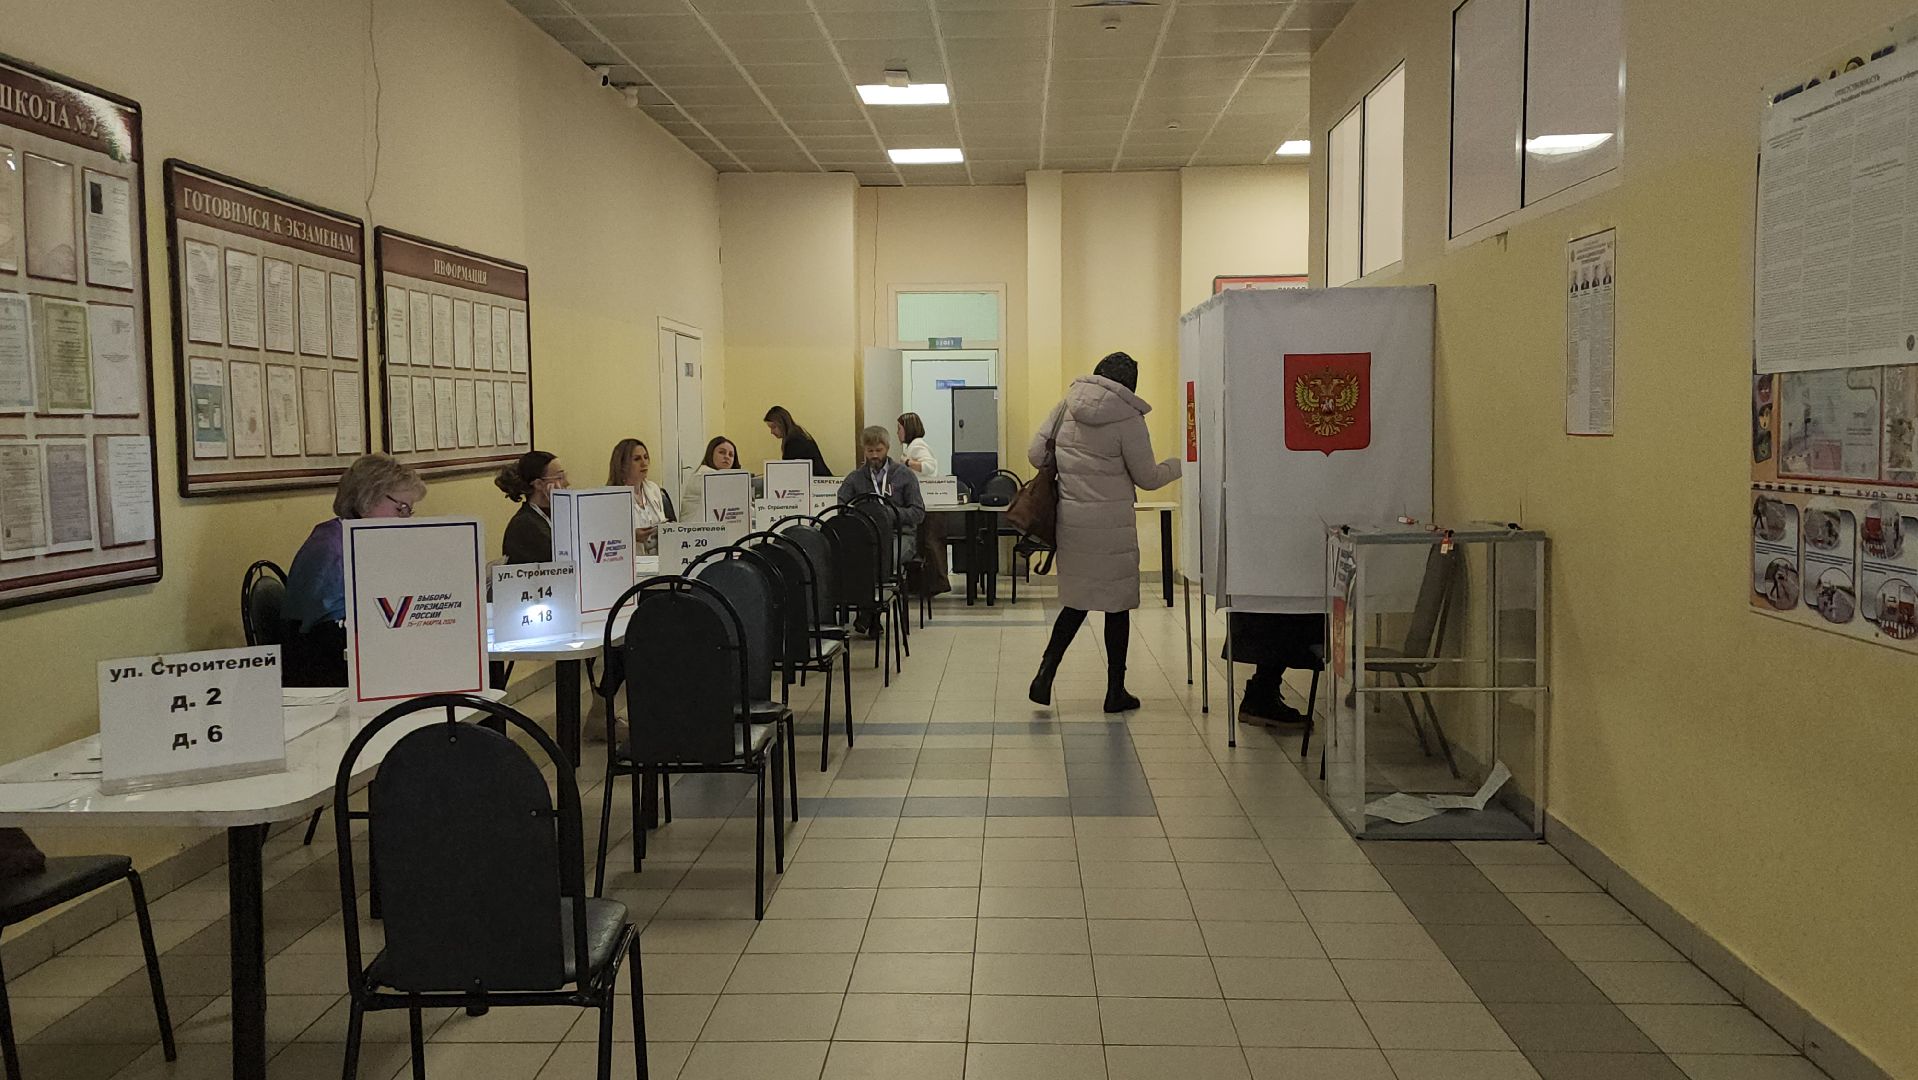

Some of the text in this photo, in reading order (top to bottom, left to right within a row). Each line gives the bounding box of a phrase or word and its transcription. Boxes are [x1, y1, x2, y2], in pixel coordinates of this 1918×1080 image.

[184, 187, 355, 253] ГОТОВИМСЯ К ЭКЗАМЕНАМ
[434, 259, 487, 285] ИНФОРМАЦИЯ
[678, 525, 726, 534] Строителей
[681, 539, 708, 549] д. 20
[498, 565, 574, 582] ул. Строителей
[417, 593, 453, 602] ВЫБОРЫ
[521, 586, 553, 602] д. 14
[414, 601, 462, 611] ПРЕЗИДЕНТА
[410, 611, 442, 620] РОССИИ
[521, 609, 553, 626] д. 18
[110, 652, 277, 683] ул. Строителей
[170, 687, 222, 713] д. 2
[172, 724, 223, 751] д. 6
